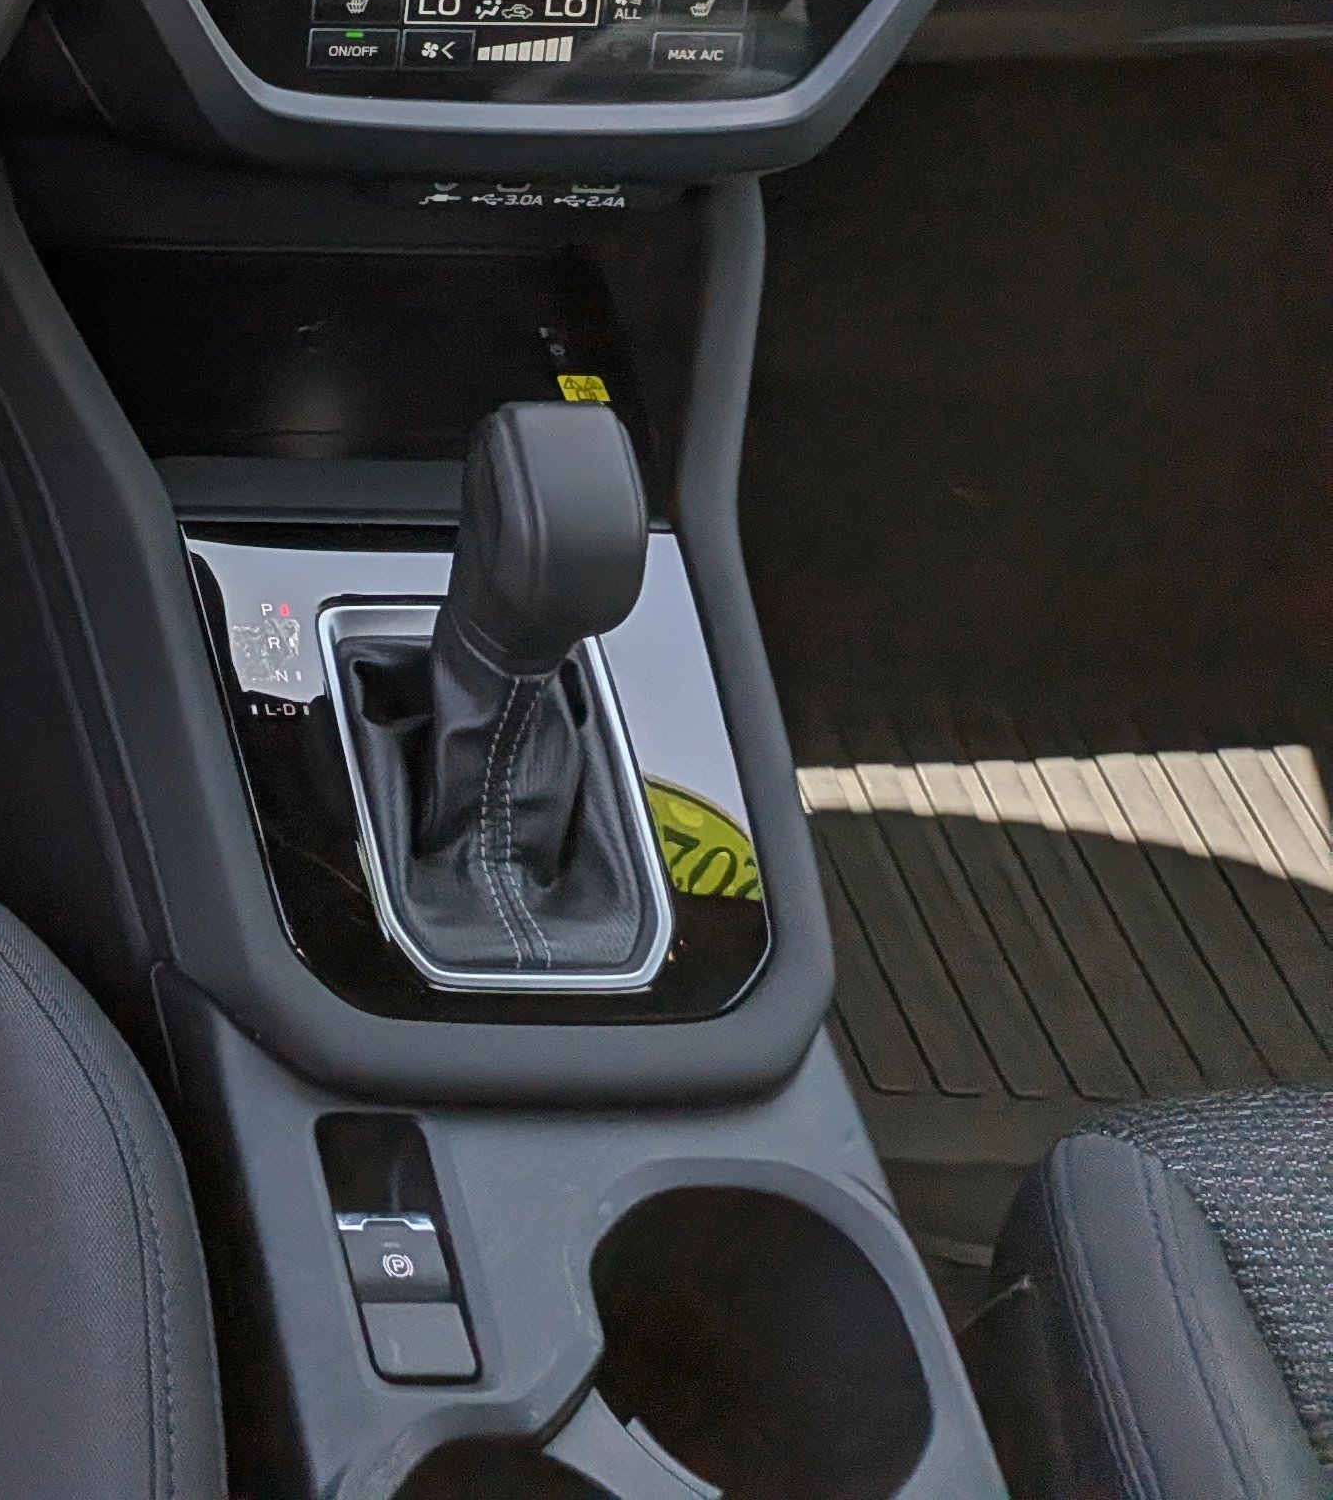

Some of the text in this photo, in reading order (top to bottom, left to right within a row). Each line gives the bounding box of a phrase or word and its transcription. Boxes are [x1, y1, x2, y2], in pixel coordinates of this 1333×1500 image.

[614, 8, 642, 20] ALL
[328, 45, 379, 57] ON/OFF
[668, 49, 724, 61] MAX A/C
[505, 194, 544, 206] 3.0A
[586, 196, 625, 208] 2.4A
[260, 603, 273, 616] P
[268, 636, 281, 649] R
[275, 669, 289, 682] N
